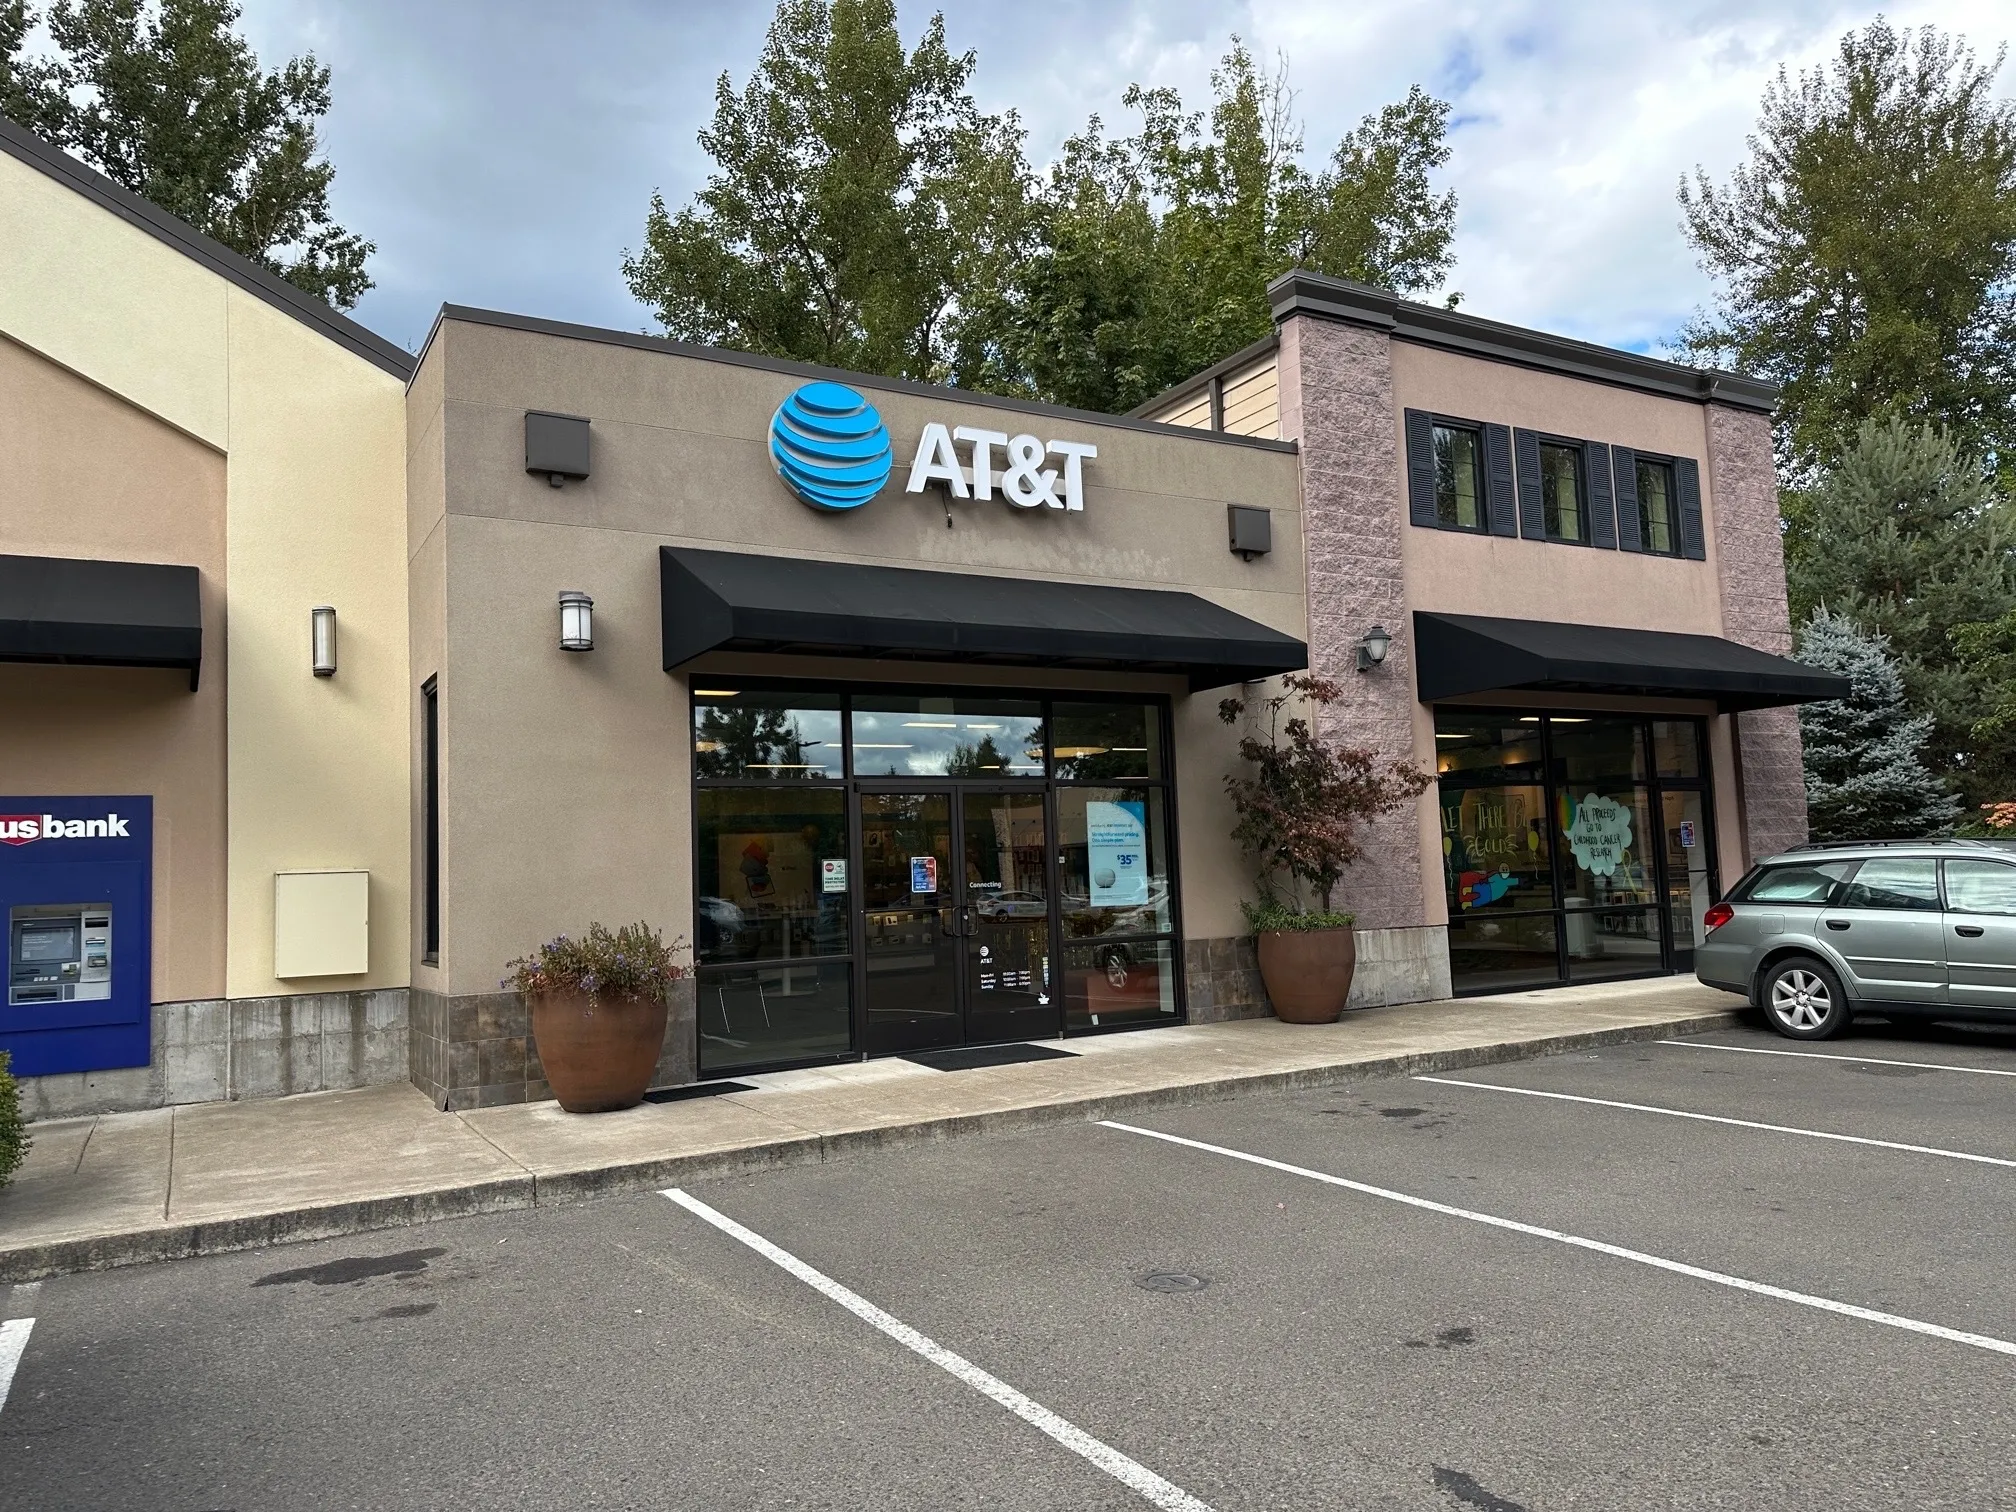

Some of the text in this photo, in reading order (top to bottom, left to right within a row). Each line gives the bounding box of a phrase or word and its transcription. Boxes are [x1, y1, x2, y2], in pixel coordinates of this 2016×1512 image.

[905, 422, 1098, 512] AT&T
[1440, 805, 1464, 833] LET
[1473, 802, 1507, 831] THERE
[1578, 806, 1617, 824] ALL PROCEEDS
[1586, 822, 1603, 833] GO TO
[1116, 854, 1132, 865] $35
[969, 881, 1002, 889] Connecting
